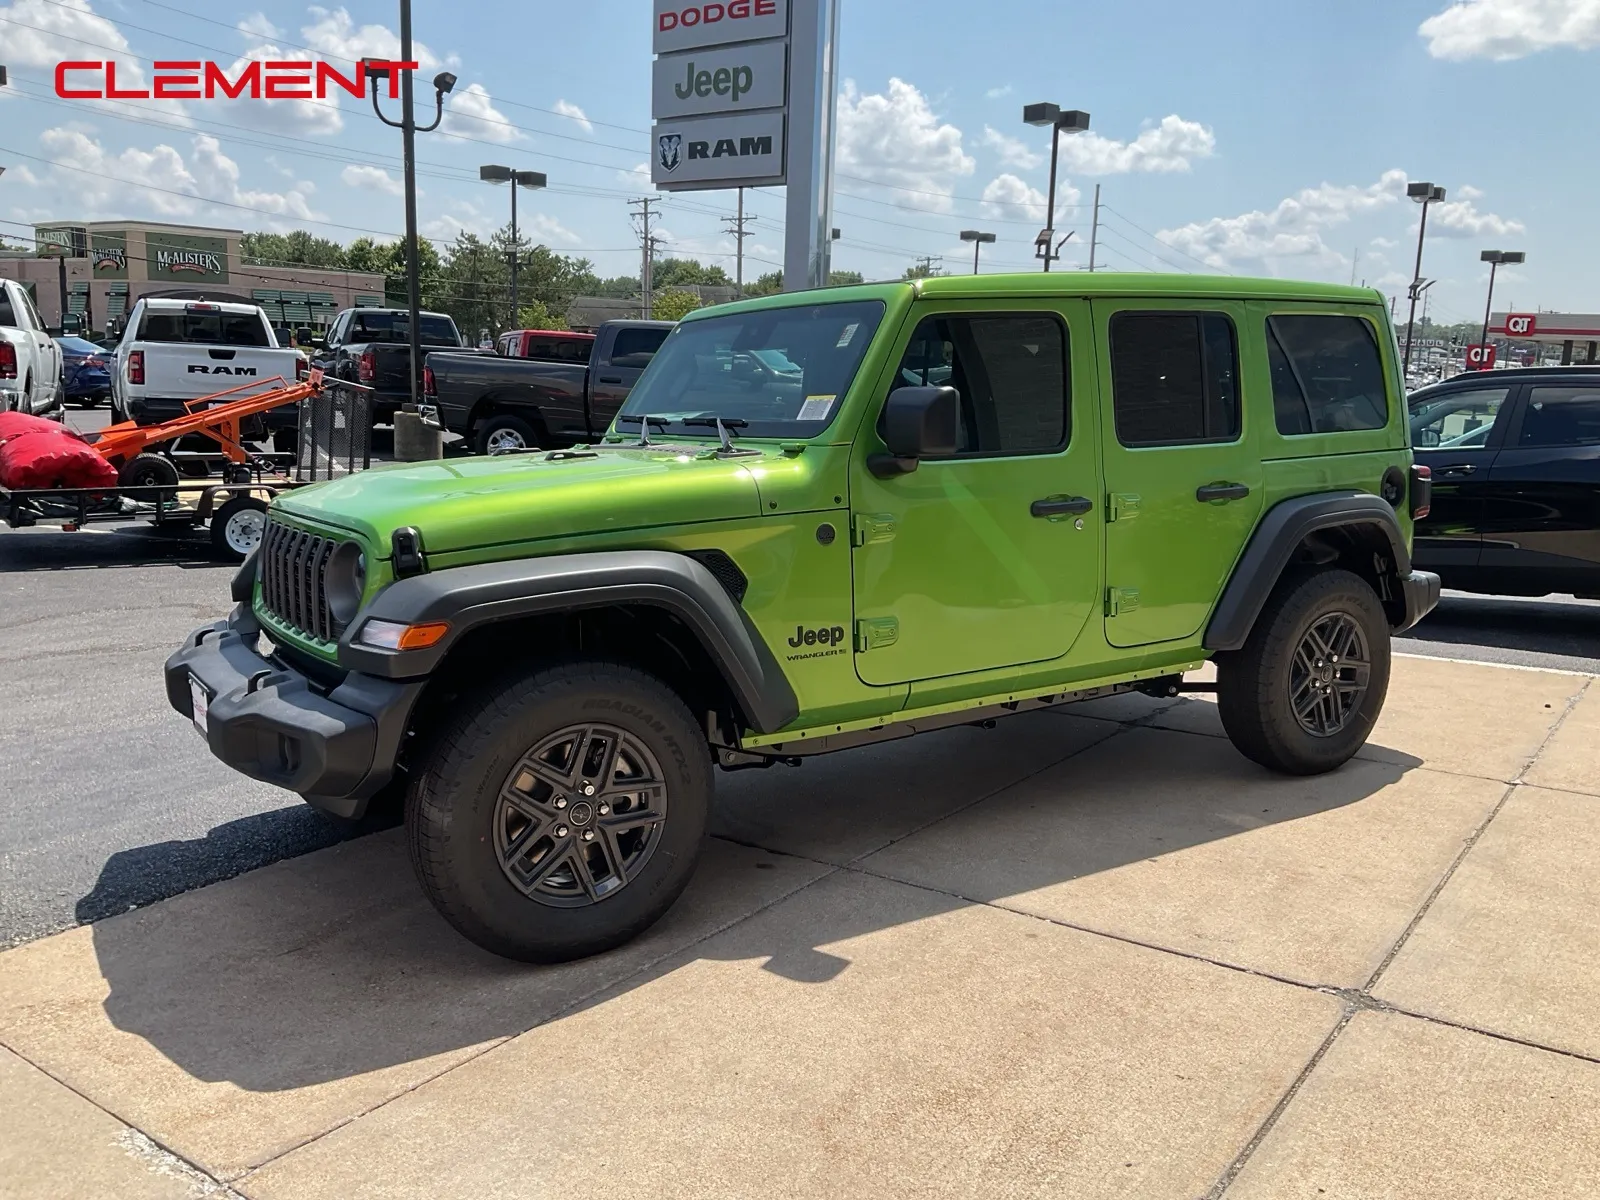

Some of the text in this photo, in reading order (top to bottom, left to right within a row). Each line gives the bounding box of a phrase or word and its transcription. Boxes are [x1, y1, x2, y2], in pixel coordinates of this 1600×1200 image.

[659, 0, 776, 32] DODGE
[675, 62, 753, 101] Jeep
[688, 136, 772, 160] RAM
[157, 250, 221, 275] McALISTER'S
[1508, 317, 1531, 333] QT
[1470, 347, 1491, 362] QT
[187, 364, 257, 376] RAM
[788, 625, 845, 648] Jeep
[786, 649, 838, 662] WRANGLER
